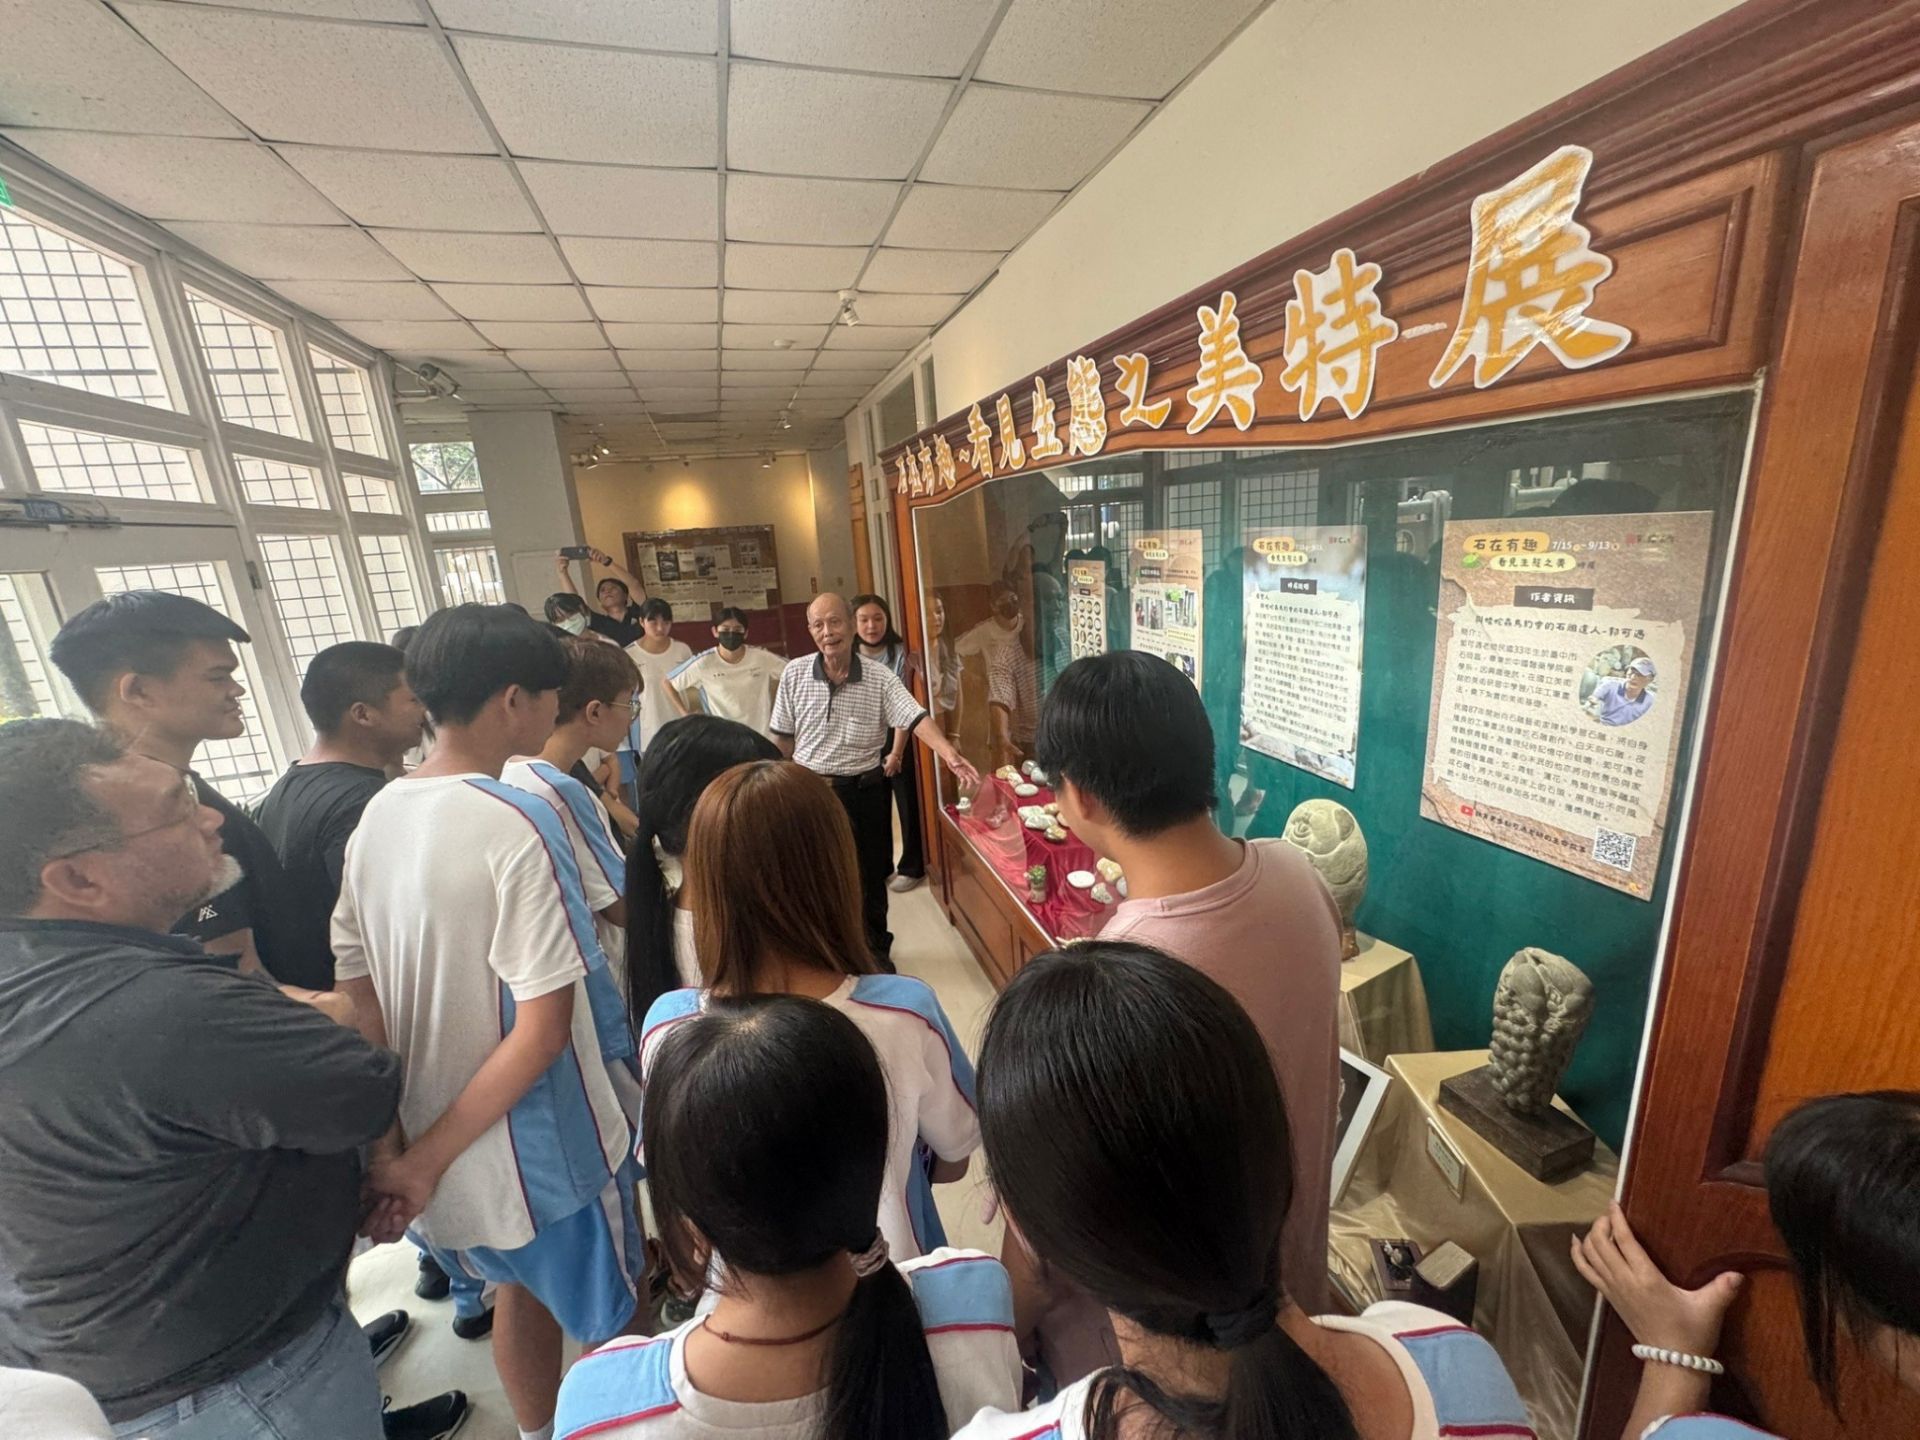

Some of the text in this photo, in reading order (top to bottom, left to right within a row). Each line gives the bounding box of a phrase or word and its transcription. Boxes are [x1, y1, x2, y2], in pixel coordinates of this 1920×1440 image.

[1473, 538, 1538, 552] 石在有趣
[1530, 592, 1575, 604] 作者資訊
